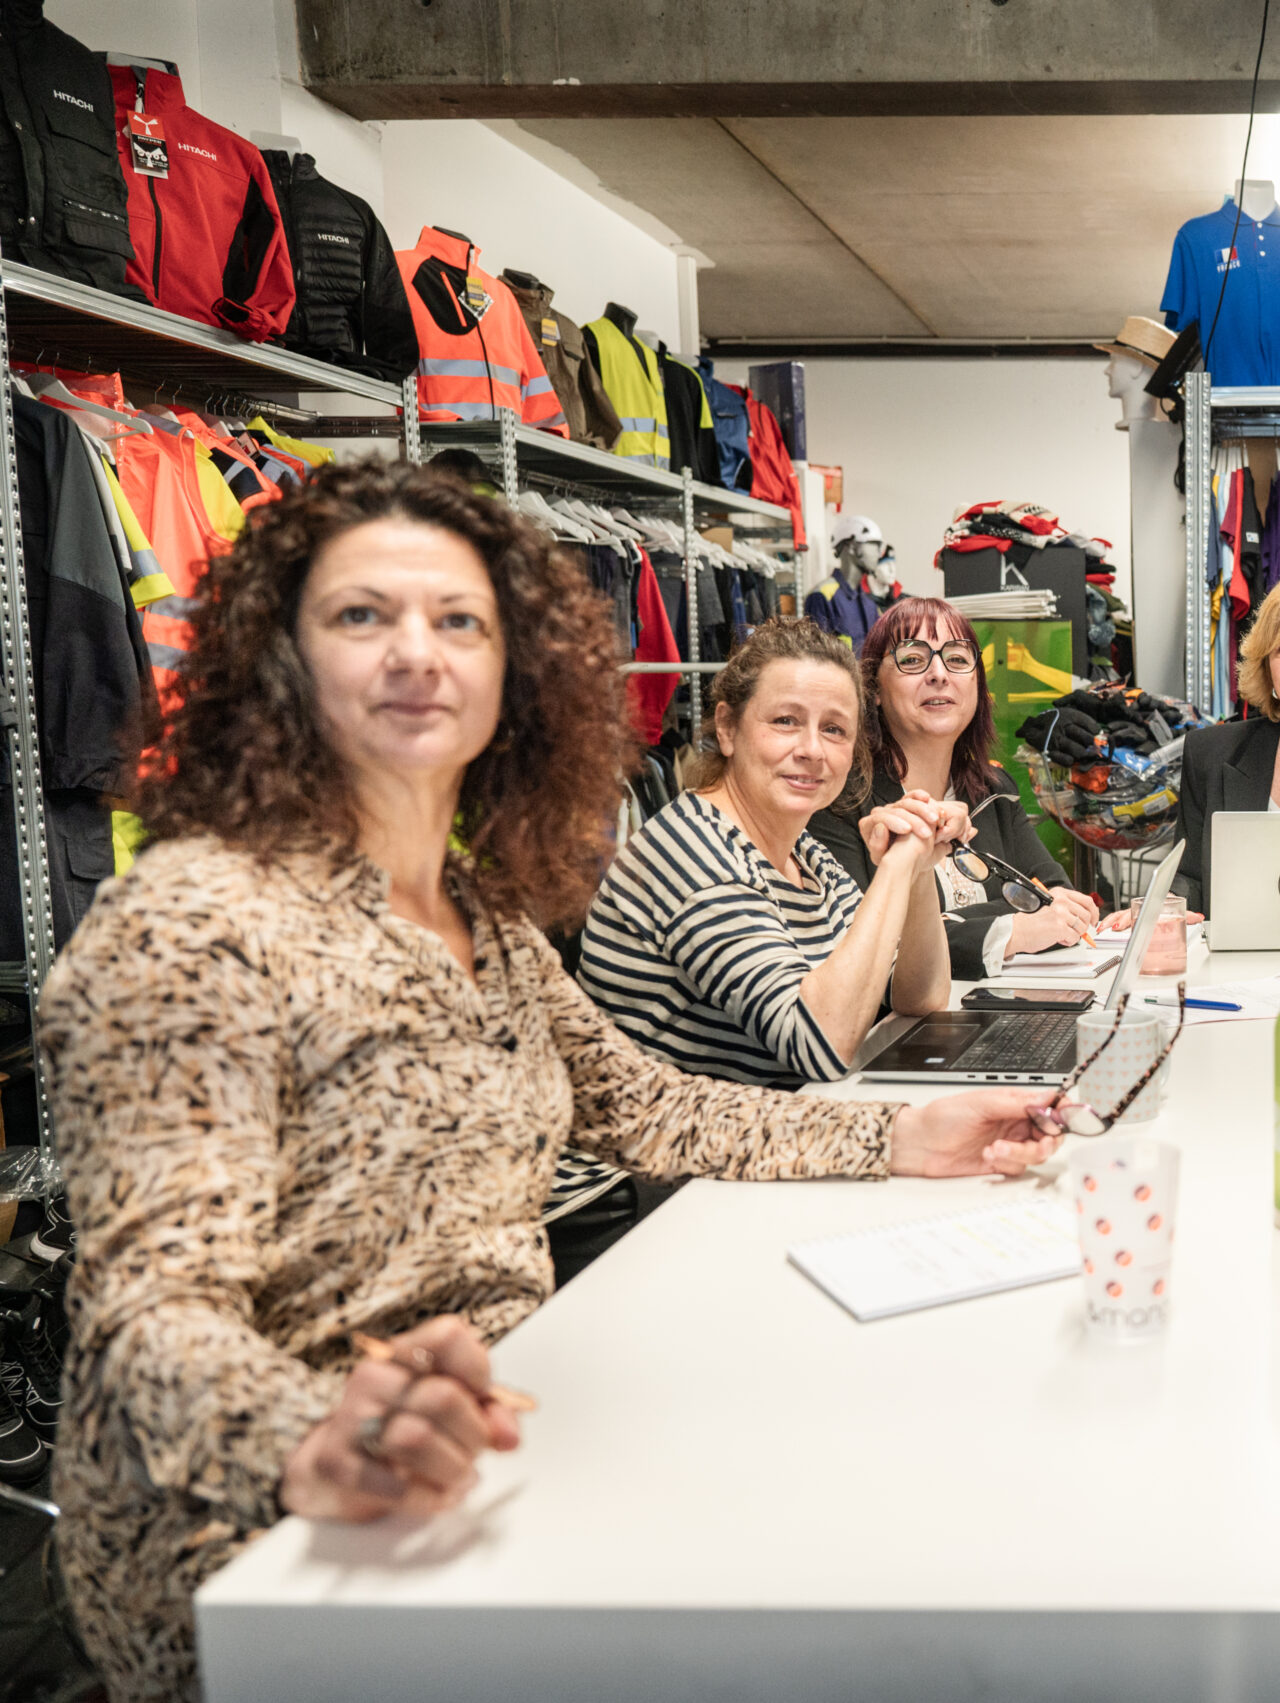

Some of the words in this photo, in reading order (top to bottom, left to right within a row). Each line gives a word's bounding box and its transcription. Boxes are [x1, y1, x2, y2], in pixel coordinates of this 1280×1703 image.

[53, 89, 94, 112] HITACHI
[178, 142, 217, 161] HITACHI
[317, 233, 350, 245] HITACHI
